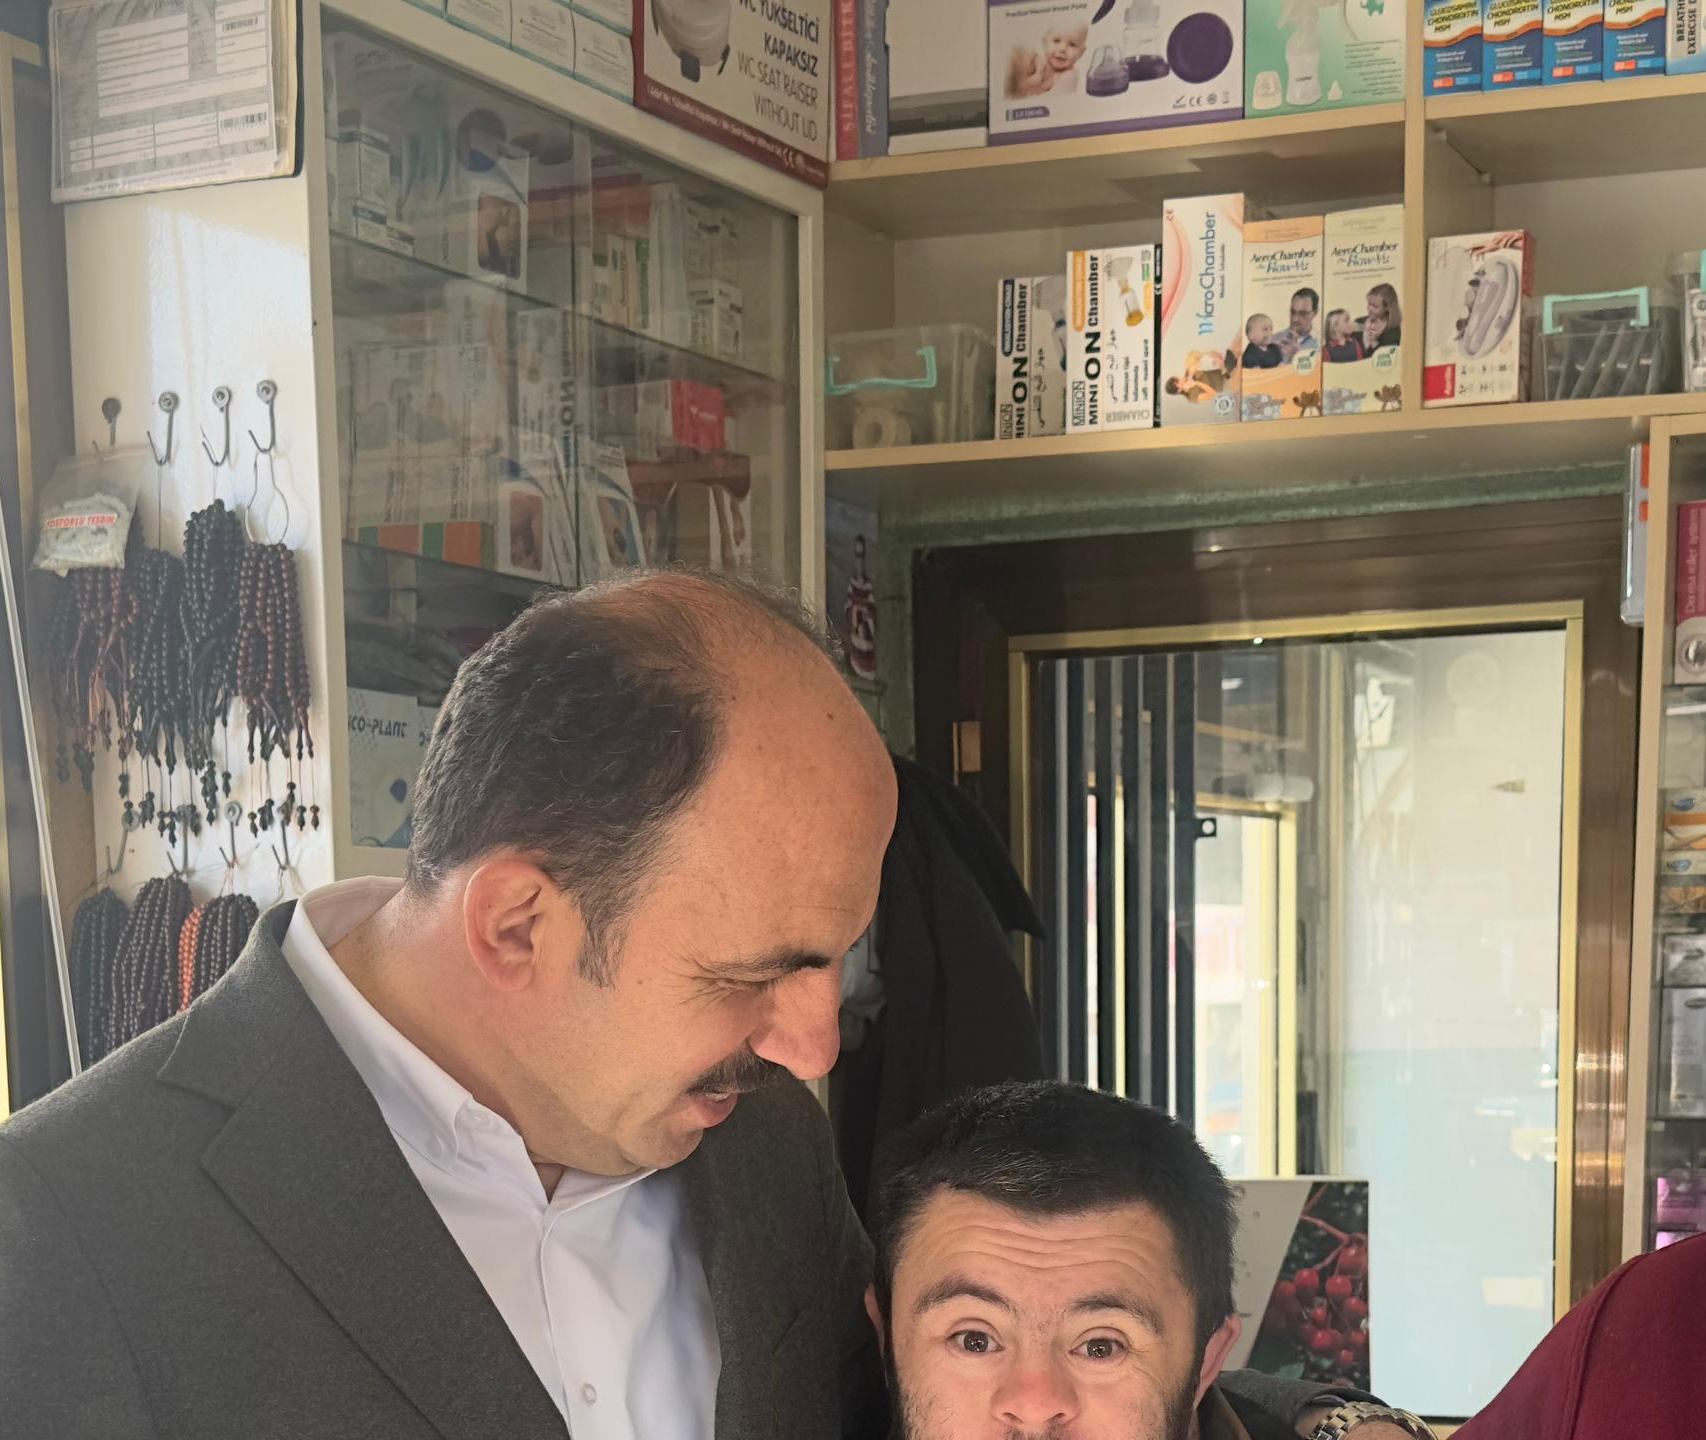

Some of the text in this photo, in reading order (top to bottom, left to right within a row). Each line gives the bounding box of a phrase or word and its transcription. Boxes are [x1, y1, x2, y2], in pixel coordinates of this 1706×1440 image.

[1554, 11, 1571, 21] MSM
[1615, 5, 1634, 15] MSM
[1434, 23, 1451, 32] MSM
[1494, 17, 1511, 27] MSM
[764, 33, 819, 78] KAPAKSIZ
[738, 50, 756, 79] WC
[758, 62, 782, 91] SEAT
[1250, 249, 1317, 264] AeroChamber
[1332, 241, 1399, 257] AeroChamber
[1198, 210, 1217, 336] MicroChamber
[1088, 255, 1099, 328] Chamber
[1016, 283, 1029, 353] Chamber
